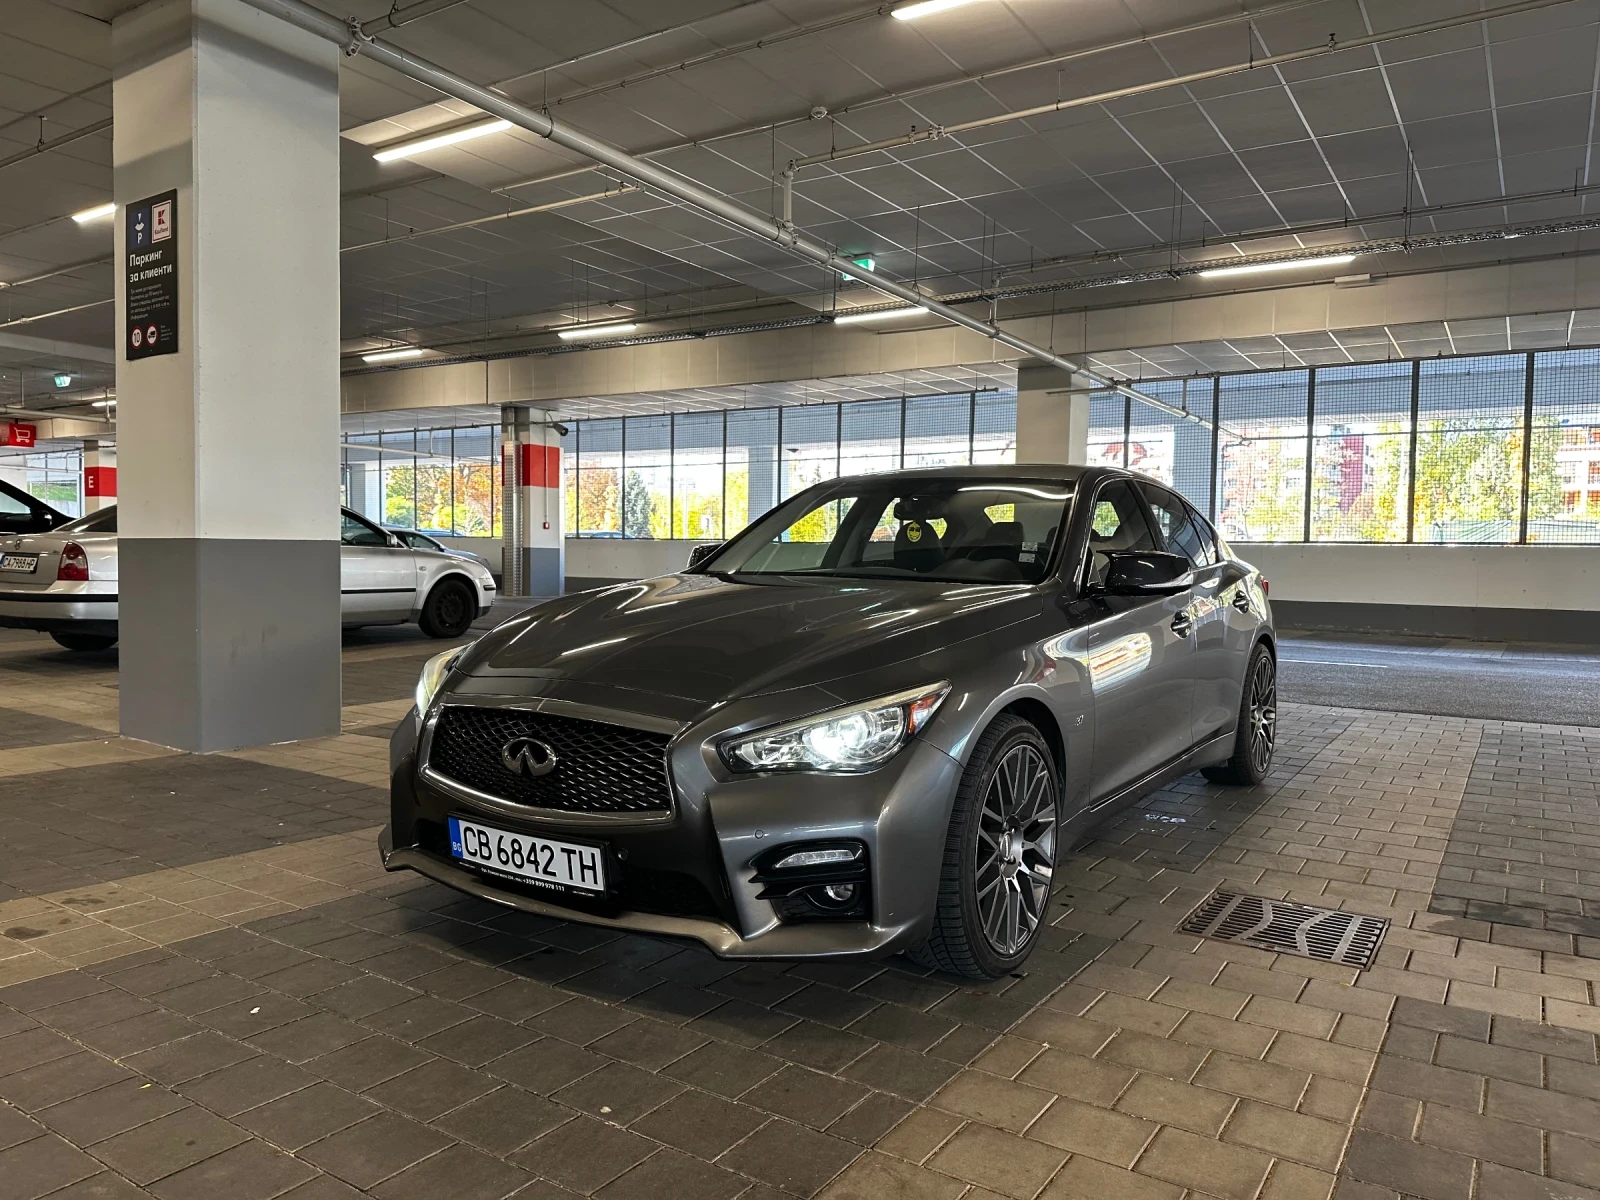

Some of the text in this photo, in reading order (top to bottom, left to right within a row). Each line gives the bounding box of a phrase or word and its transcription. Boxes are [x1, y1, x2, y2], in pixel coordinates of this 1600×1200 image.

[129, 250, 163, 268] Паркинг
[129, 264, 173, 283] за клиенти
[133, 331, 140, 343] 10
[88, 475, 94, 488] E
[452, 841, 462, 852] BG
[463, 826, 599, 885] CB 6842 TH
